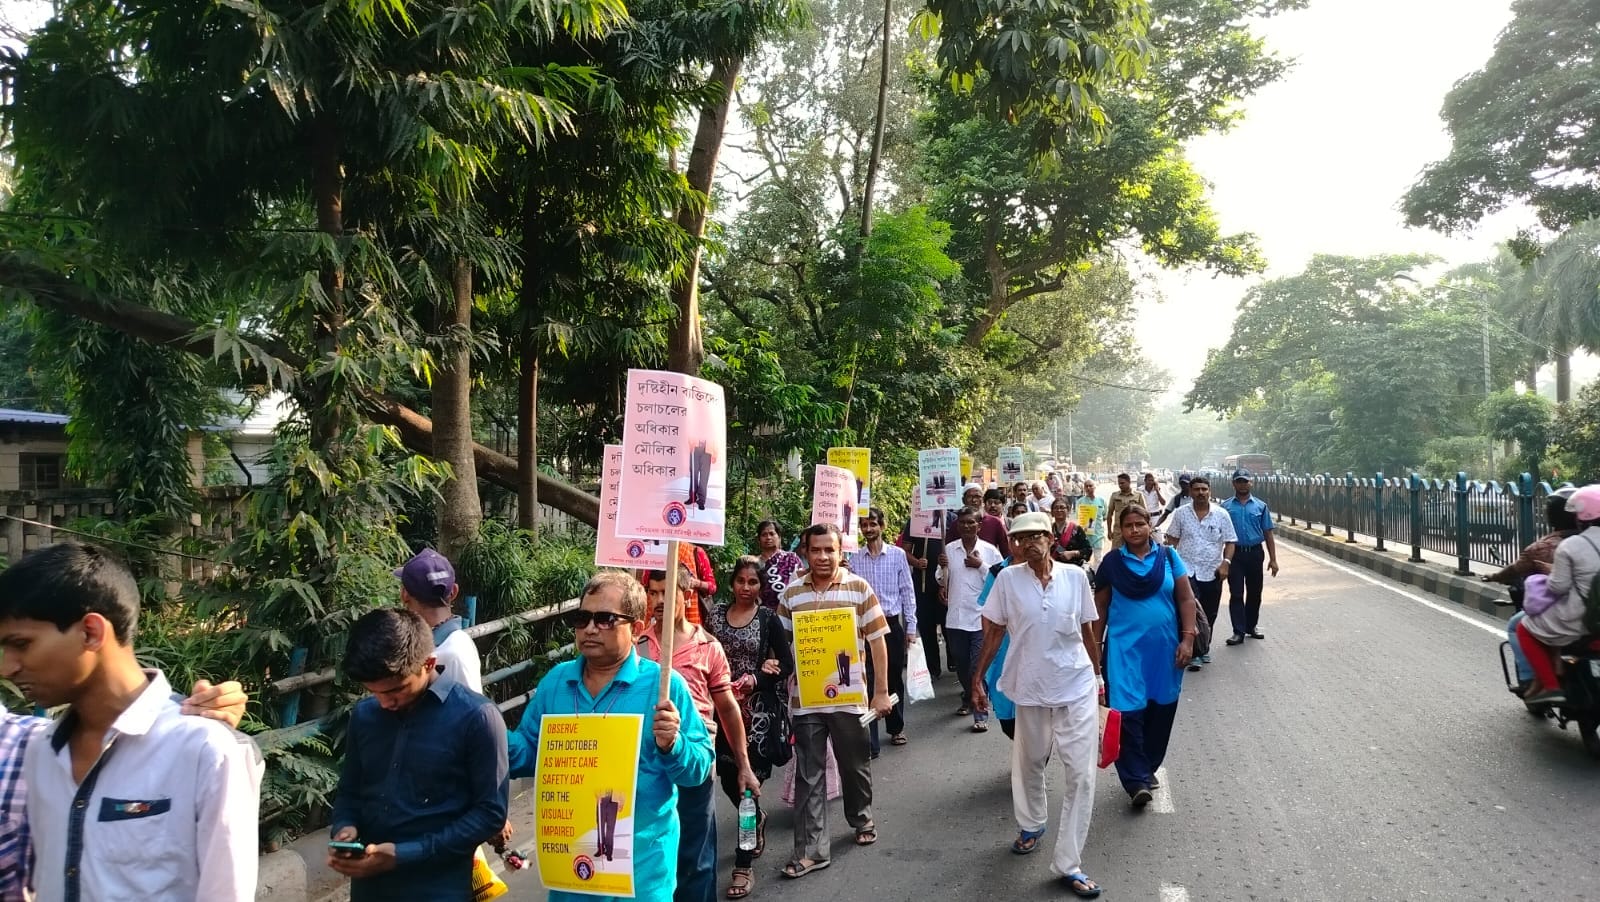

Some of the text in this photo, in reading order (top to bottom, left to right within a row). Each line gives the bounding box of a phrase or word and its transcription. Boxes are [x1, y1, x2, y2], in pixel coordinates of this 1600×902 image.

[638, 379, 678, 396] দৃষ্টিহীন
[636, 402, 687, 416] চলাচলের
[635, 420, 679, 436] অধিকার
[635, 441, 676, 456] মৌলিক
[632, 461, 676, 477] অধিকার
[547, 723, 579, 734] OBSERVE
[546, 740, 598, 751] 15TH OCTOBER
[543, 757, 598, 768] AS WHITE CANE
[542, 774, 585, 785] SAFETY DAY
[541, 791, 570, 802] FOR THE
[541, 809, 574, 820] VISUALLY
[541, 826, 575, 837] IMPAIRED
